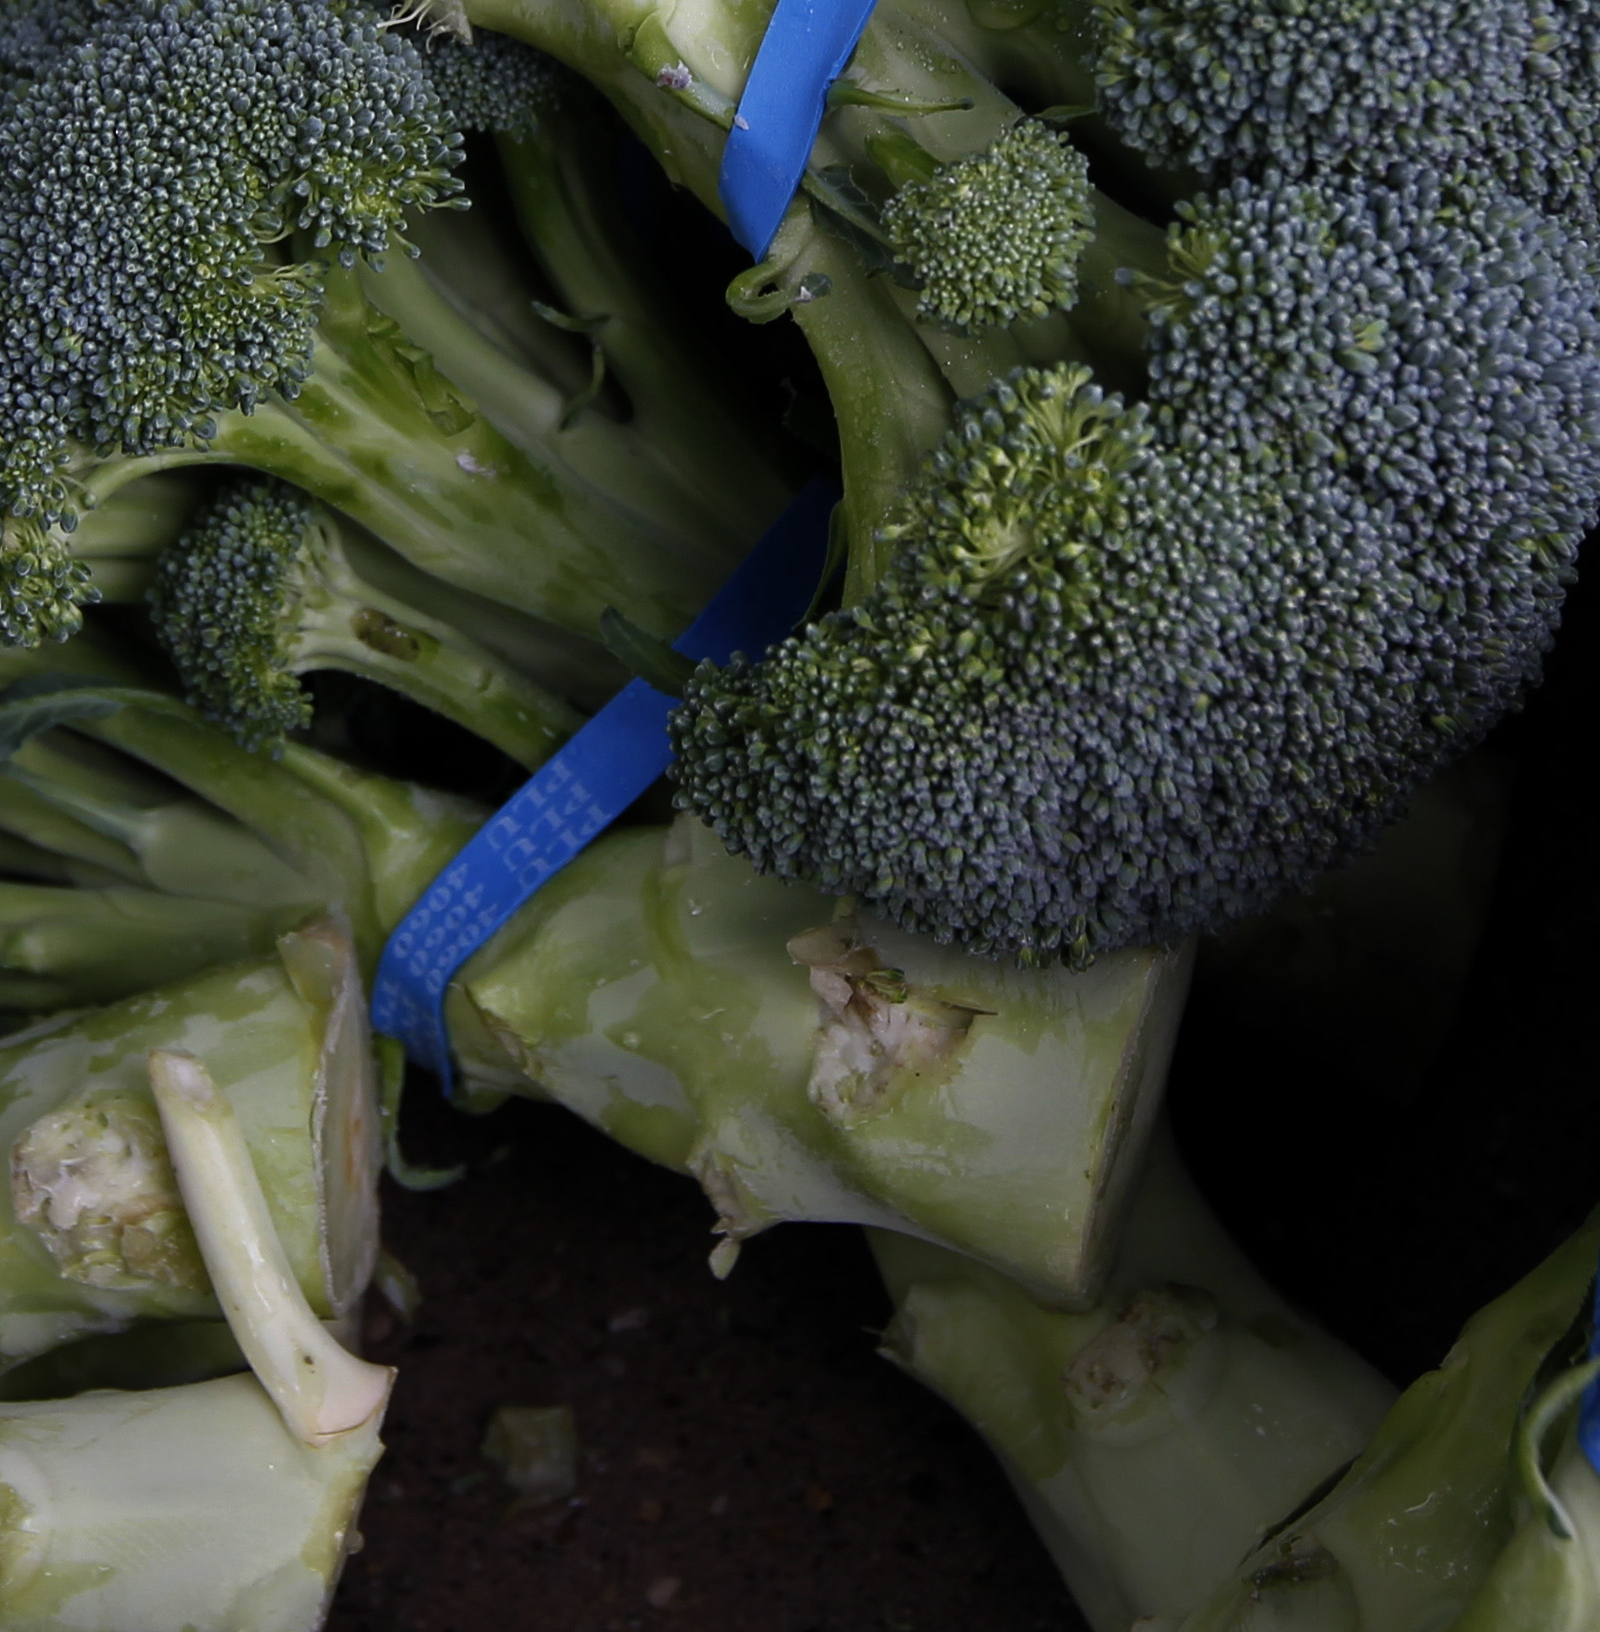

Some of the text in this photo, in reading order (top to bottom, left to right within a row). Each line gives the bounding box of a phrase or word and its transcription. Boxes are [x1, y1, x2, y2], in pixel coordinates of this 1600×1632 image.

[486, 758, 574, 850] PLU
[502, 781, 593, 873] PLU
[393, 863, 469, 960] 4060
[408, 884, 485, 978] 4060
[425, 803, 613, 996] PLU 4060
